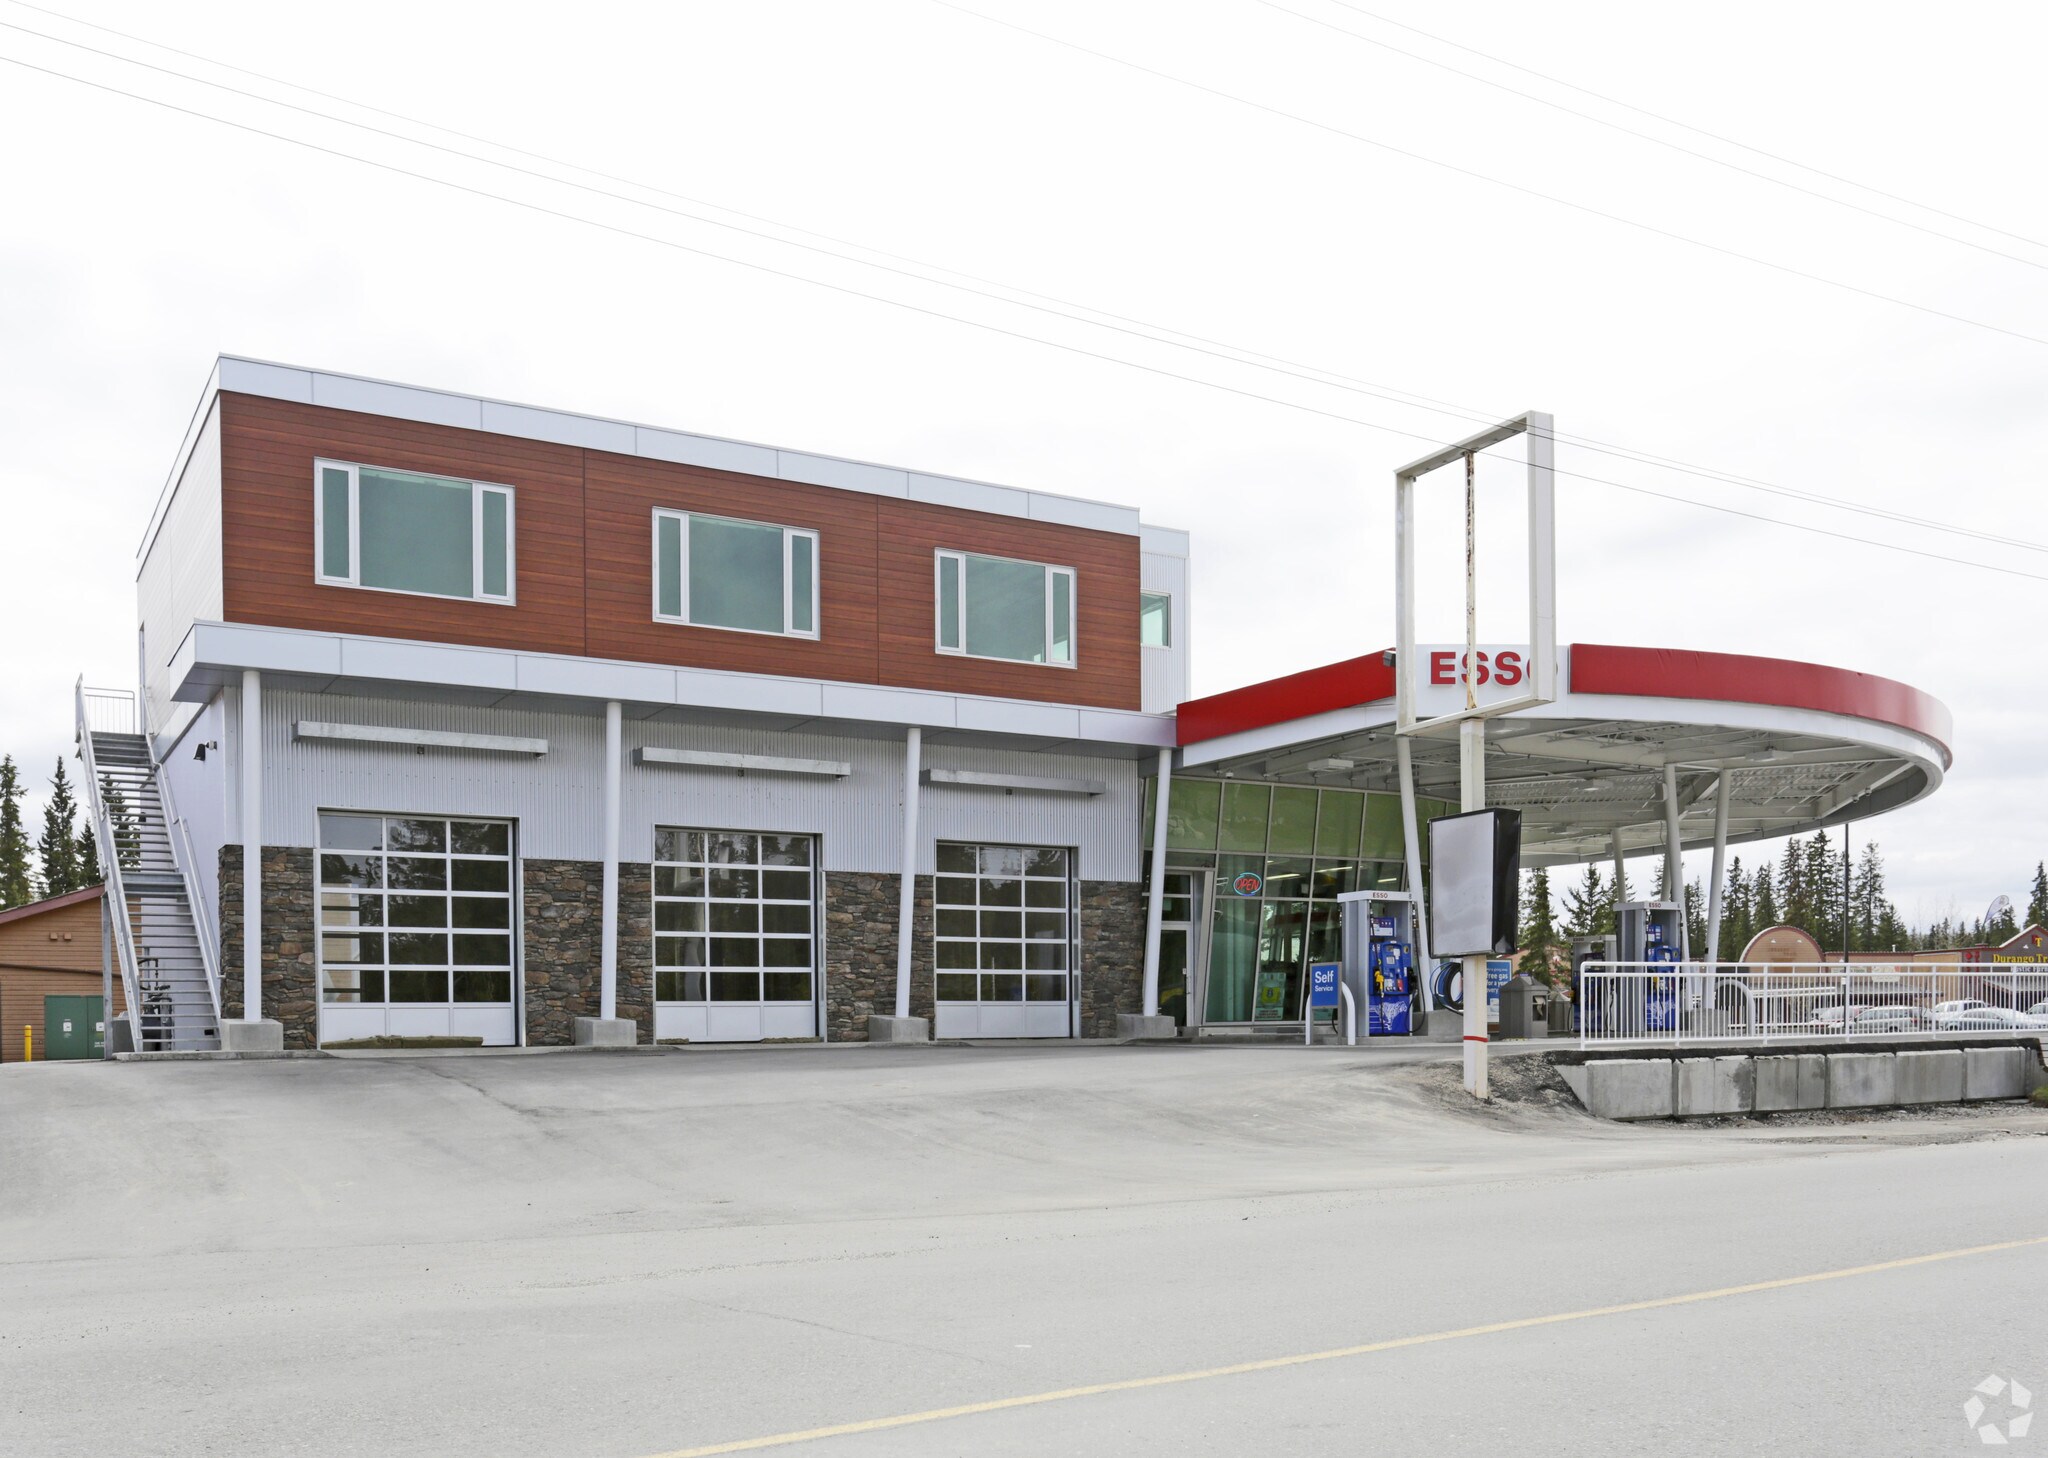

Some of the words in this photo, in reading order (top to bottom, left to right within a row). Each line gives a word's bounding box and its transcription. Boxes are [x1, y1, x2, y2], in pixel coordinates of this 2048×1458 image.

[1430, 651, 1558, 686] ESS
[1236, 878, 1260, 891] OPEN
[1993, 954, 2034, 963] Durango
[2036, 954, 2048, 963] Tr
[1314, 970, 1334, 984] Self
